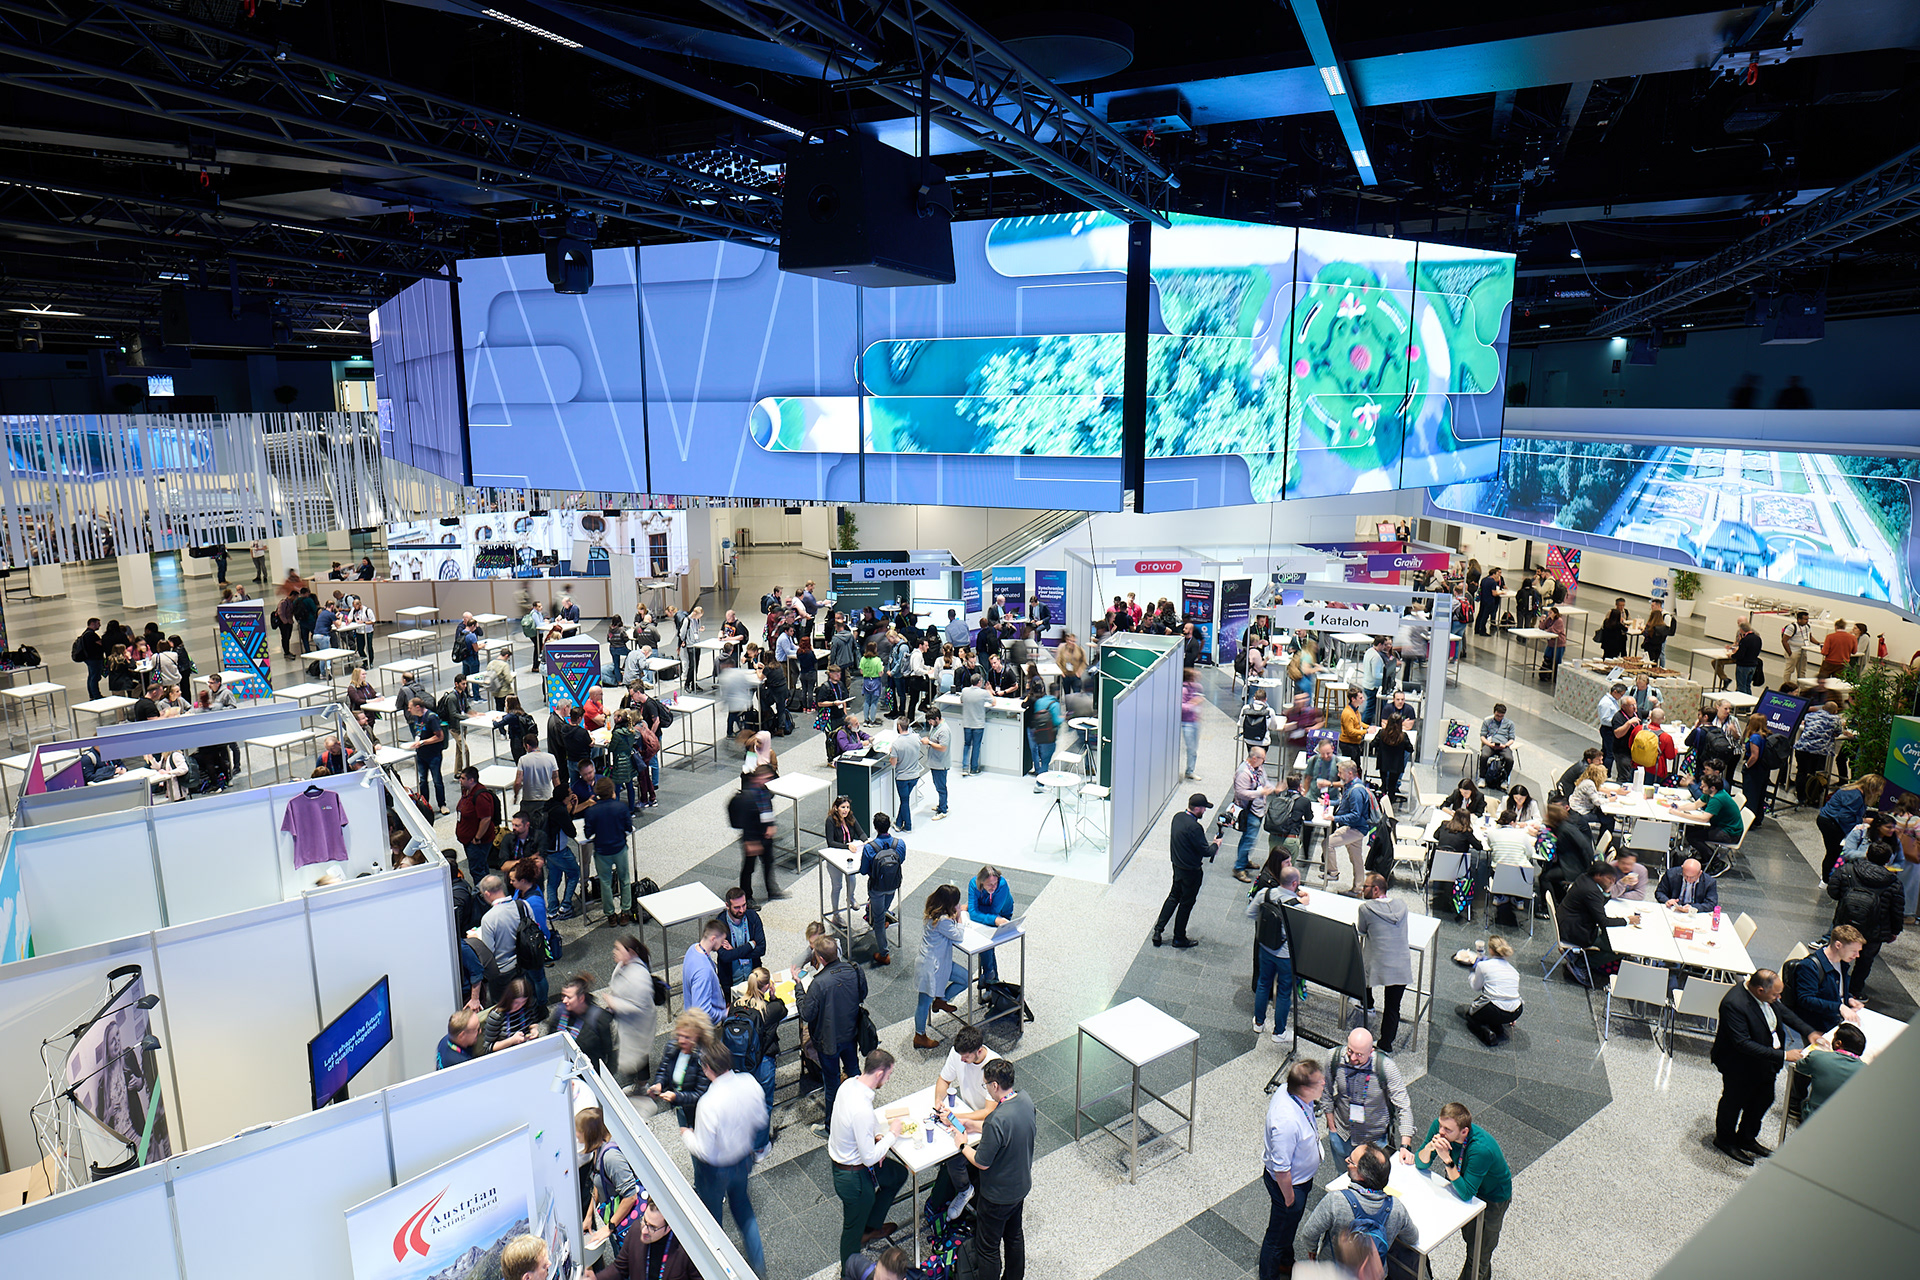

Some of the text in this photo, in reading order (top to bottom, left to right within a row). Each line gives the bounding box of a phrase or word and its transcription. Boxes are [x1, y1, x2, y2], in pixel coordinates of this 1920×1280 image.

[1140, 562, 1177, 572] provar
[1393, 555, 1423, 567] Gravity
[878, 567, 926, 578] opentext
[1320, 614, 1369, 628] Katalon
[1772, 712, 1781, 720] UI
[323, 1010, 382, 1067] Let's shape the future
[327, 1019, 380, 1072] of quality together!
[430, 1187, 497, 1227] Austrian
[430, 1213, 466, 1234] Testing
[469, 1195, 498, 1215] Board
